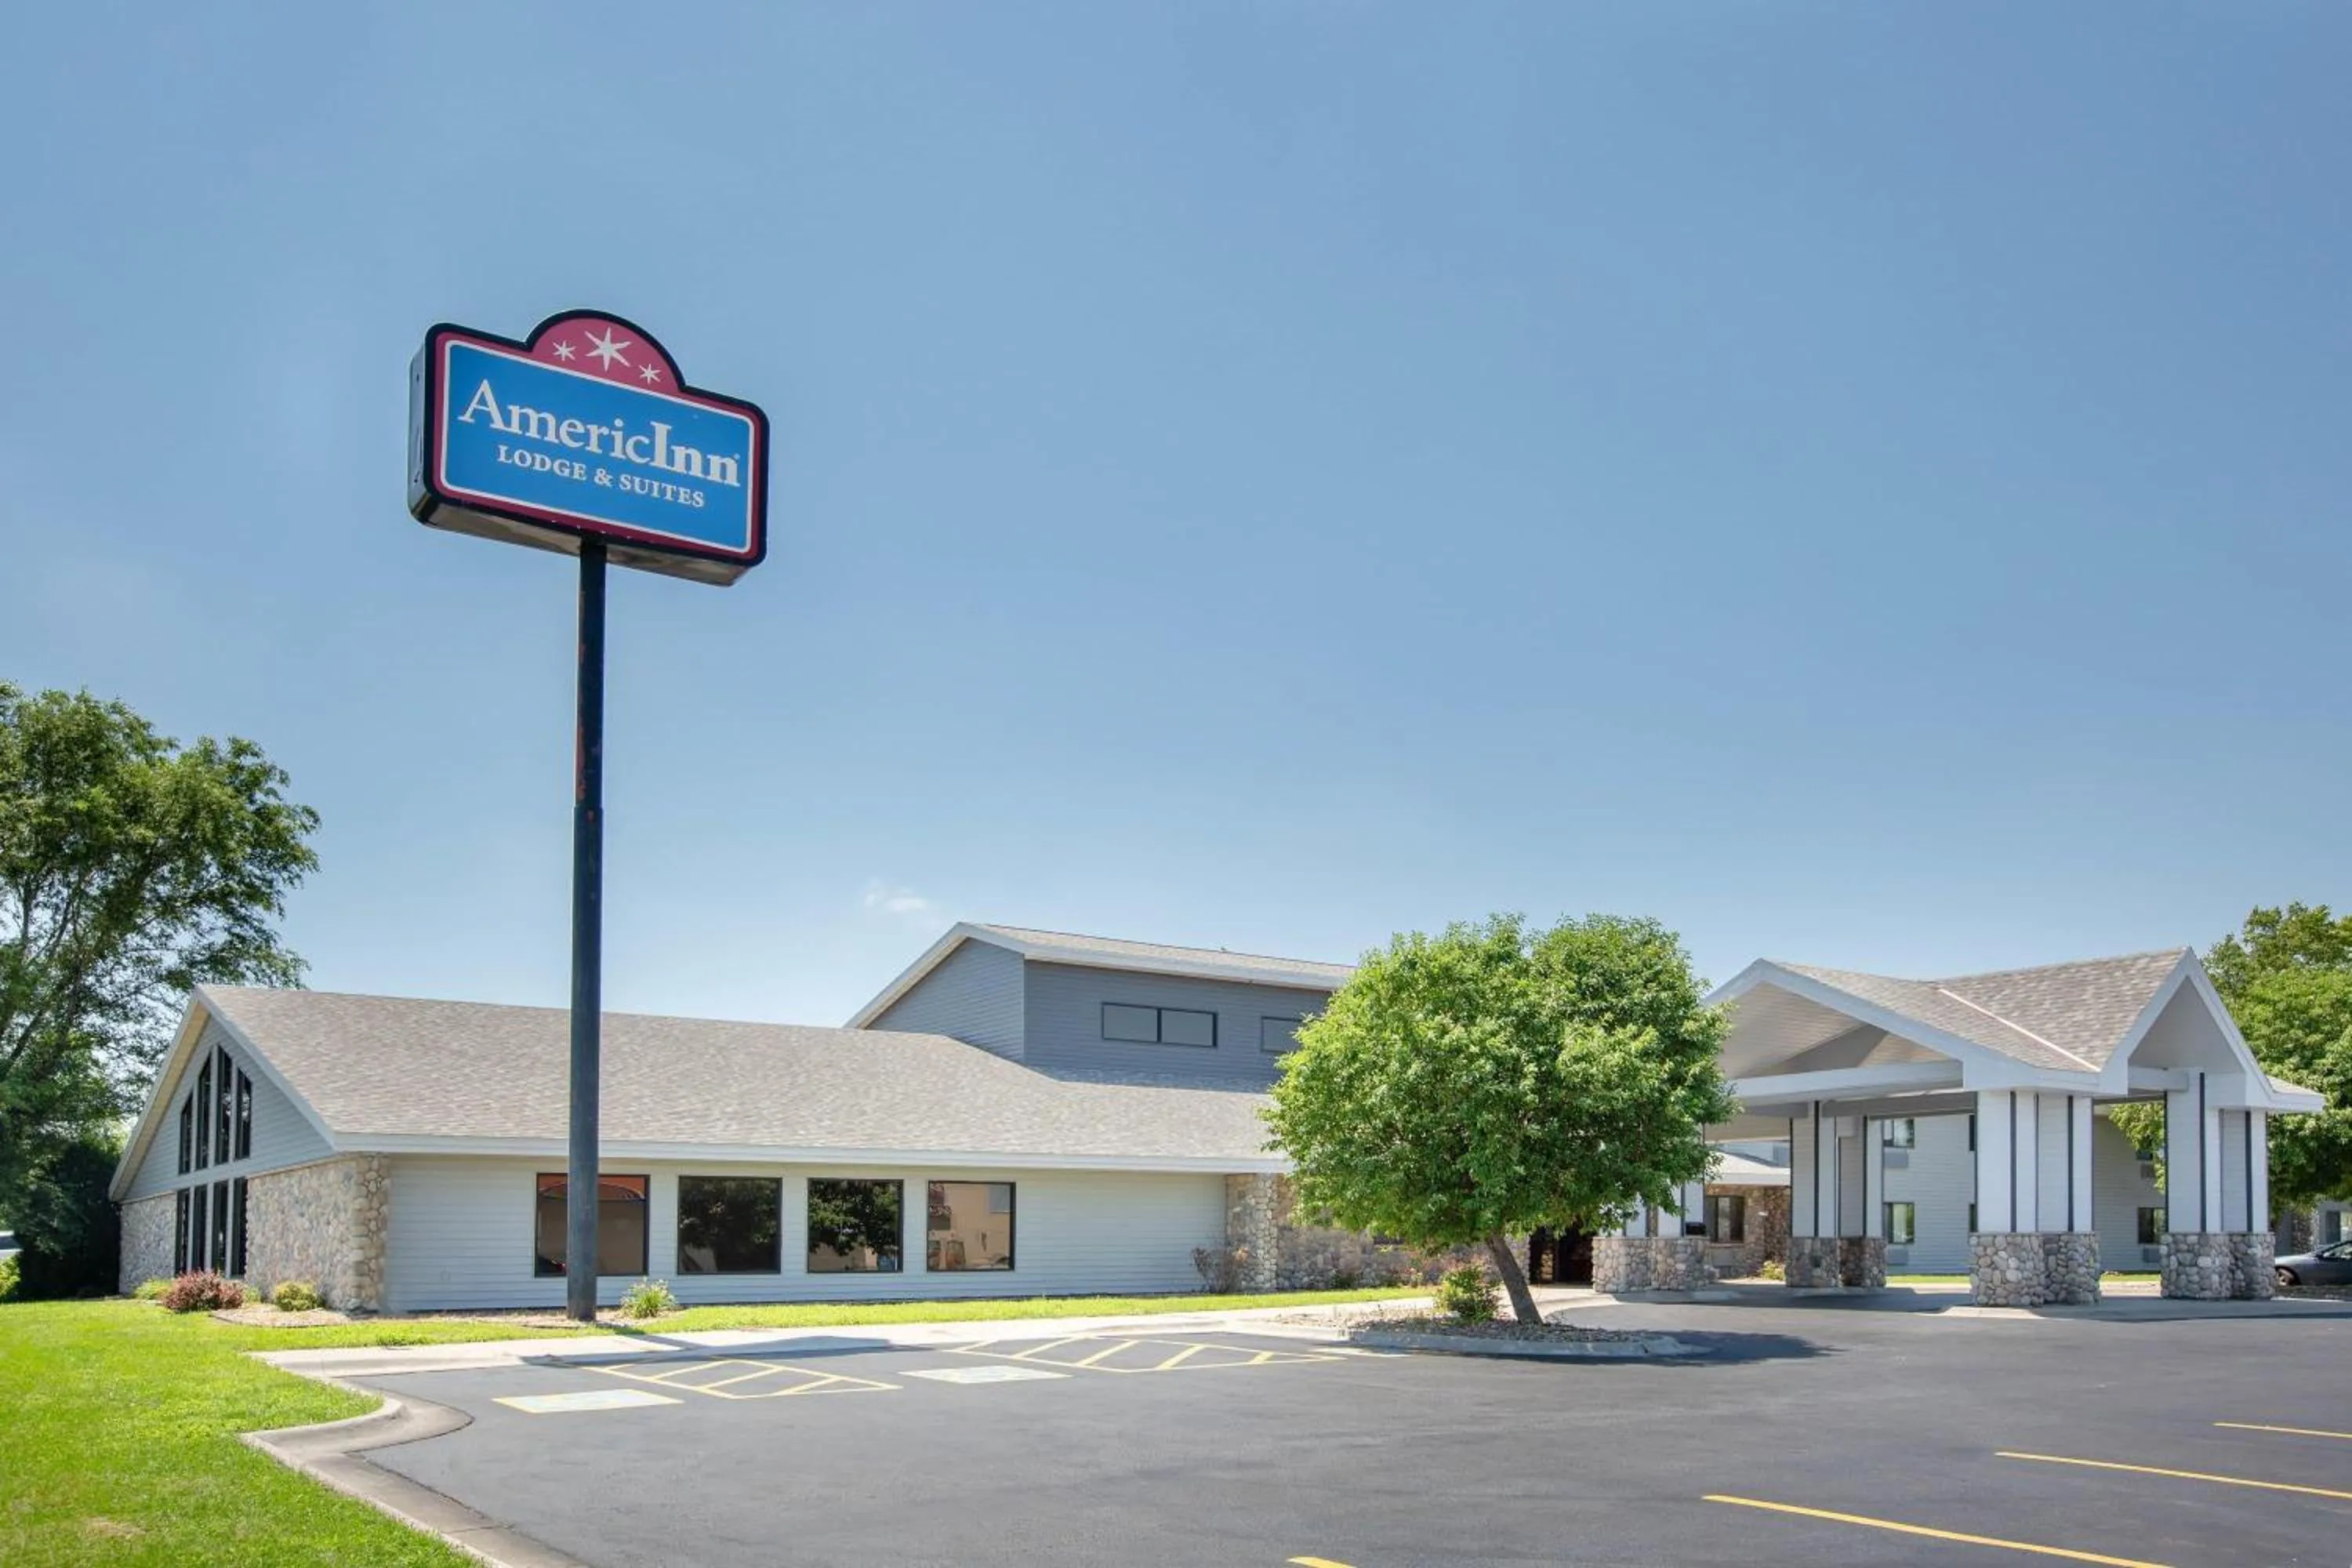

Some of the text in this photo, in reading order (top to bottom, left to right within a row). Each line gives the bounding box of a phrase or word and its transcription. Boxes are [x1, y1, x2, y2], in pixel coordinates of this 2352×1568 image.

[458, 378, 741, 487] AmericInn
[496, 445, 705, 508] LODGE & SUITES
